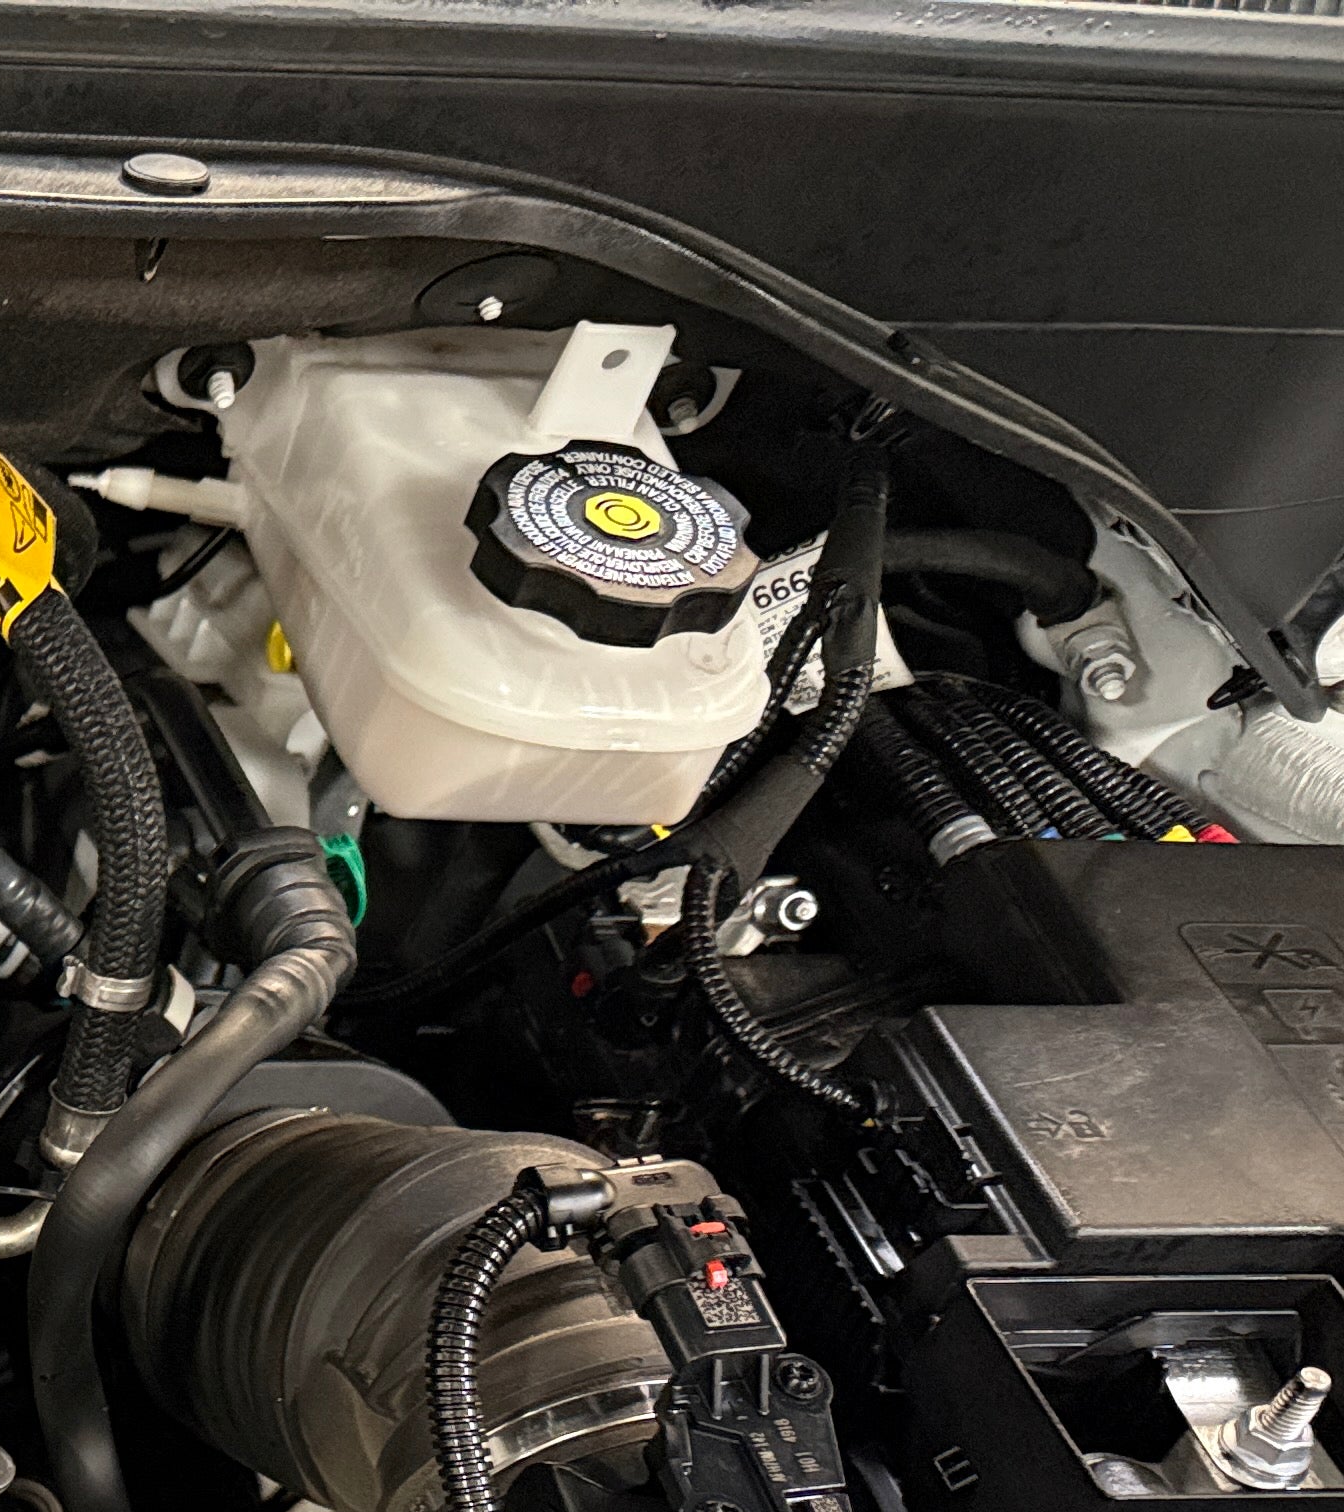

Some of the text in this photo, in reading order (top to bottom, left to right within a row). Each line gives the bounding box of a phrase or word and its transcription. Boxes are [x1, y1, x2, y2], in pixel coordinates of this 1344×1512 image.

[569, 463, 612, 475] ONLY
[582, 475, 636, 490] FILLER
[645, 462, 703, 494] SEALED
[635, 482, 684, 511] CLEAN
[508, 507, 550, 545] BOUCHON
[699, 498, 733, 526] FROM
[691, 514, 716, 549] BEFORE
[752, 565, 814, 609] 666
